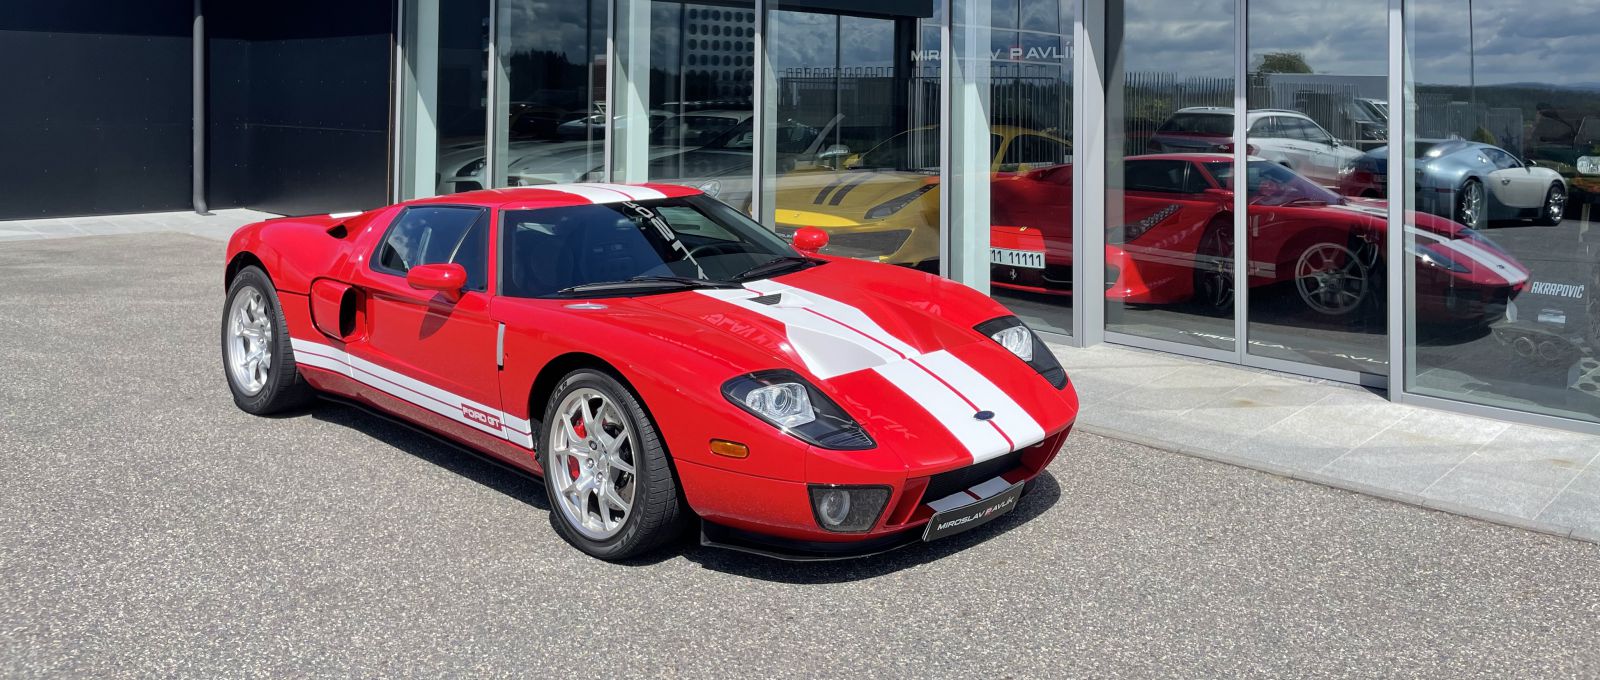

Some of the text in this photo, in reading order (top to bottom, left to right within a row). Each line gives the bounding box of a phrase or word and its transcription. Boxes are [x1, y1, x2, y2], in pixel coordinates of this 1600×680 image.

[1009, 251, 1041, 267] 11111
[463, 406, 500, 428] FORD GT
[937, 510, 985, 530] MIROSLAV
